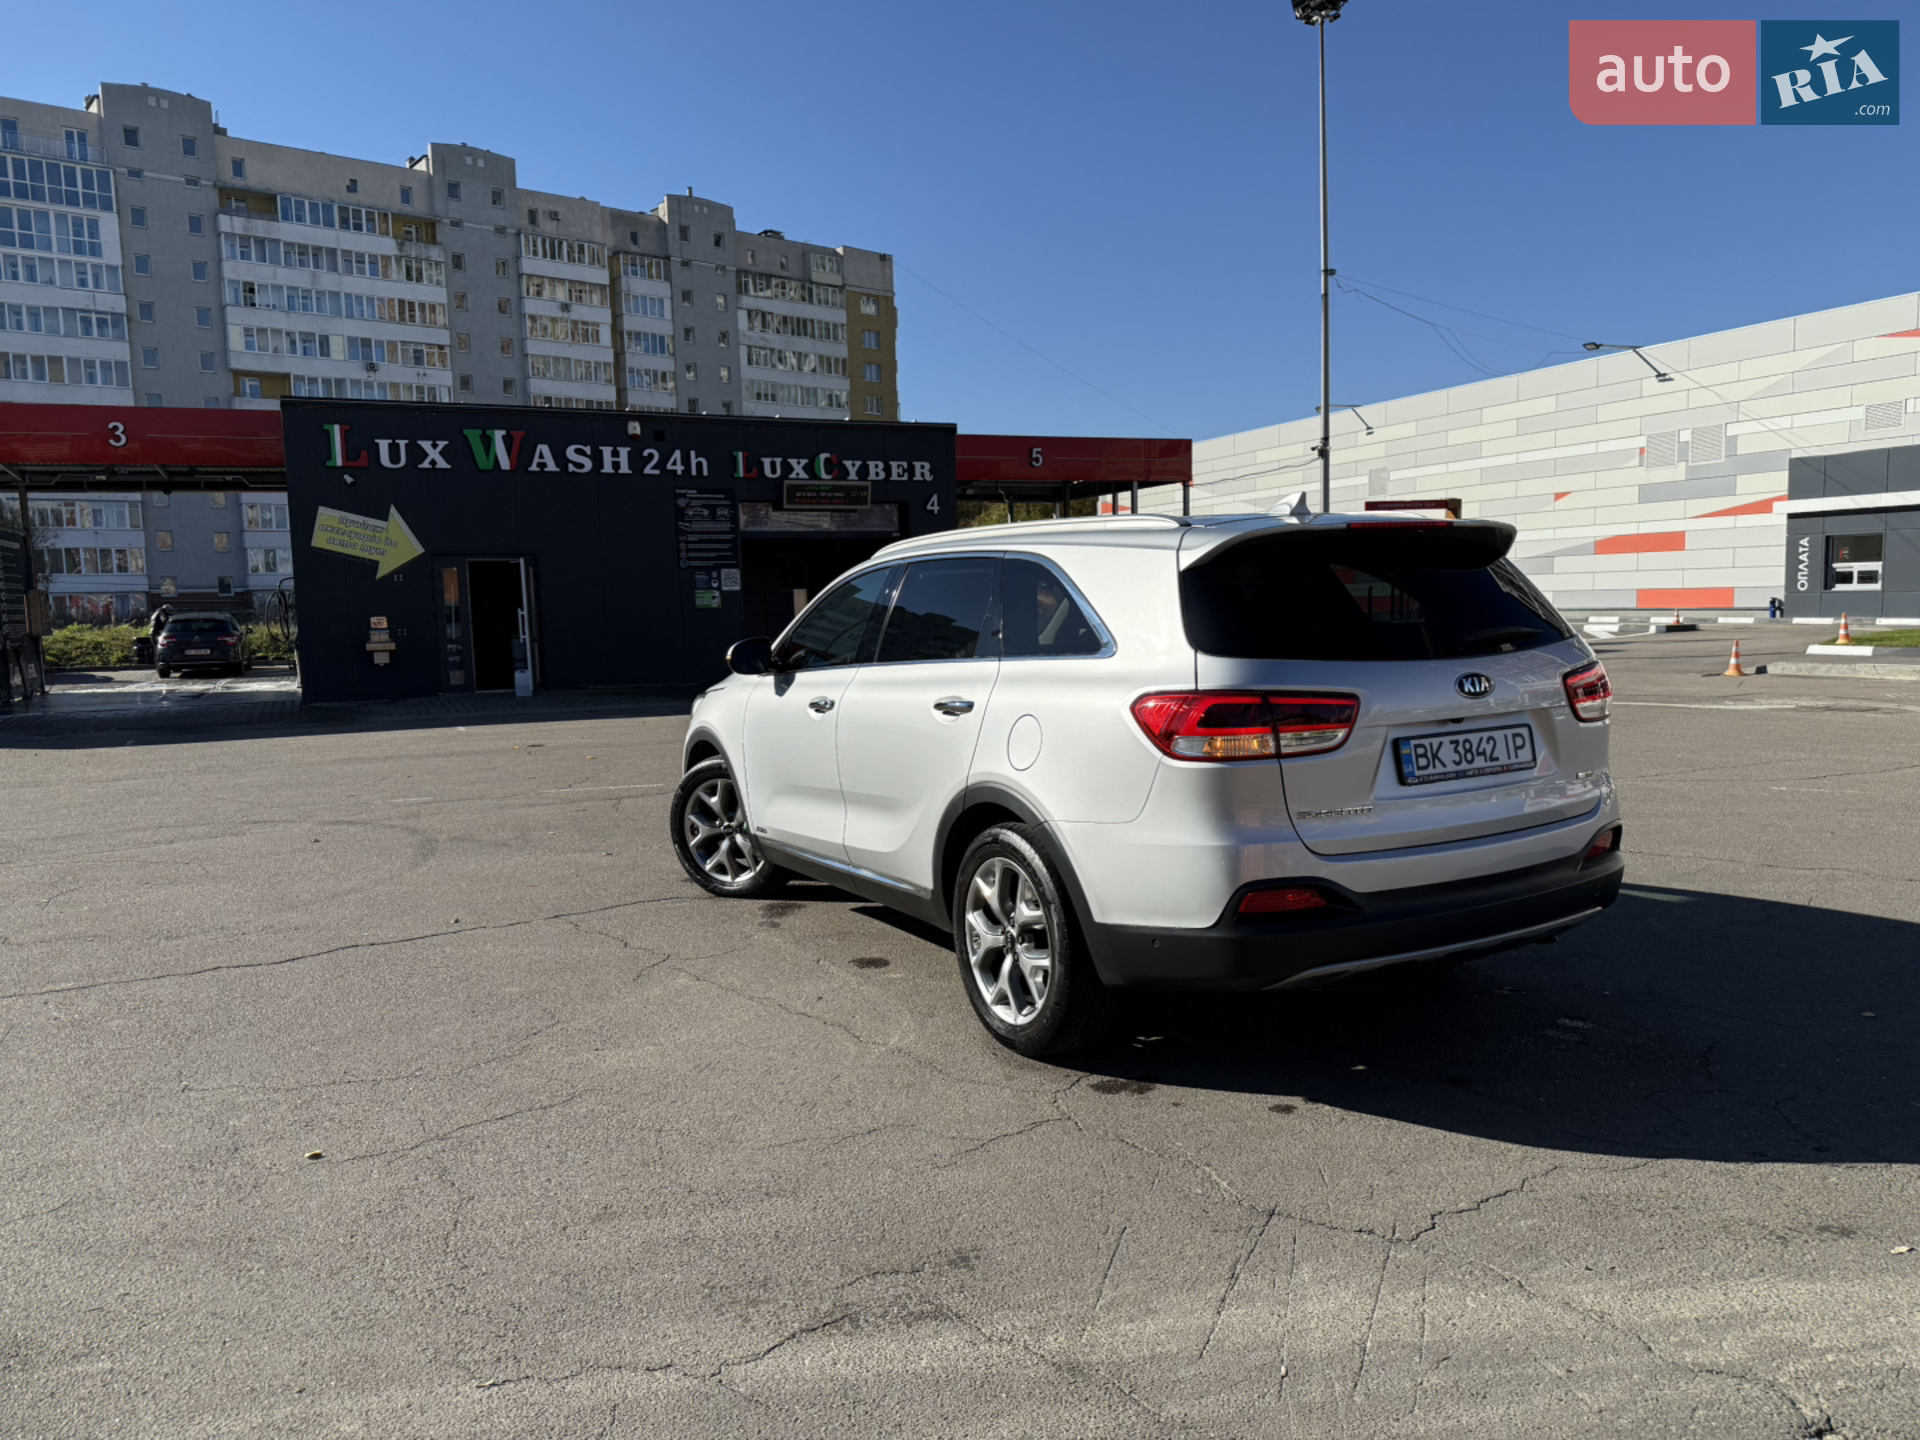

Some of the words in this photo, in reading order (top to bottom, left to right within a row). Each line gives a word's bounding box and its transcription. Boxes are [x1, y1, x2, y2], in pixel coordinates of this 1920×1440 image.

[107, 421, 127, 447] 3
[642, 448, 709, 476] 24h
[1031, 447, 1043, 467] 5
[926, 494, 940, 514] 4
[1797, 536, 1810, 591] ОПЛАТА
[1462, 676, 1489, 692] KIA
[1413, 740, 1447, 771] BK
[1449, 735, 1500, 766] 3842
[1504, 732, 1526, 760] IP
